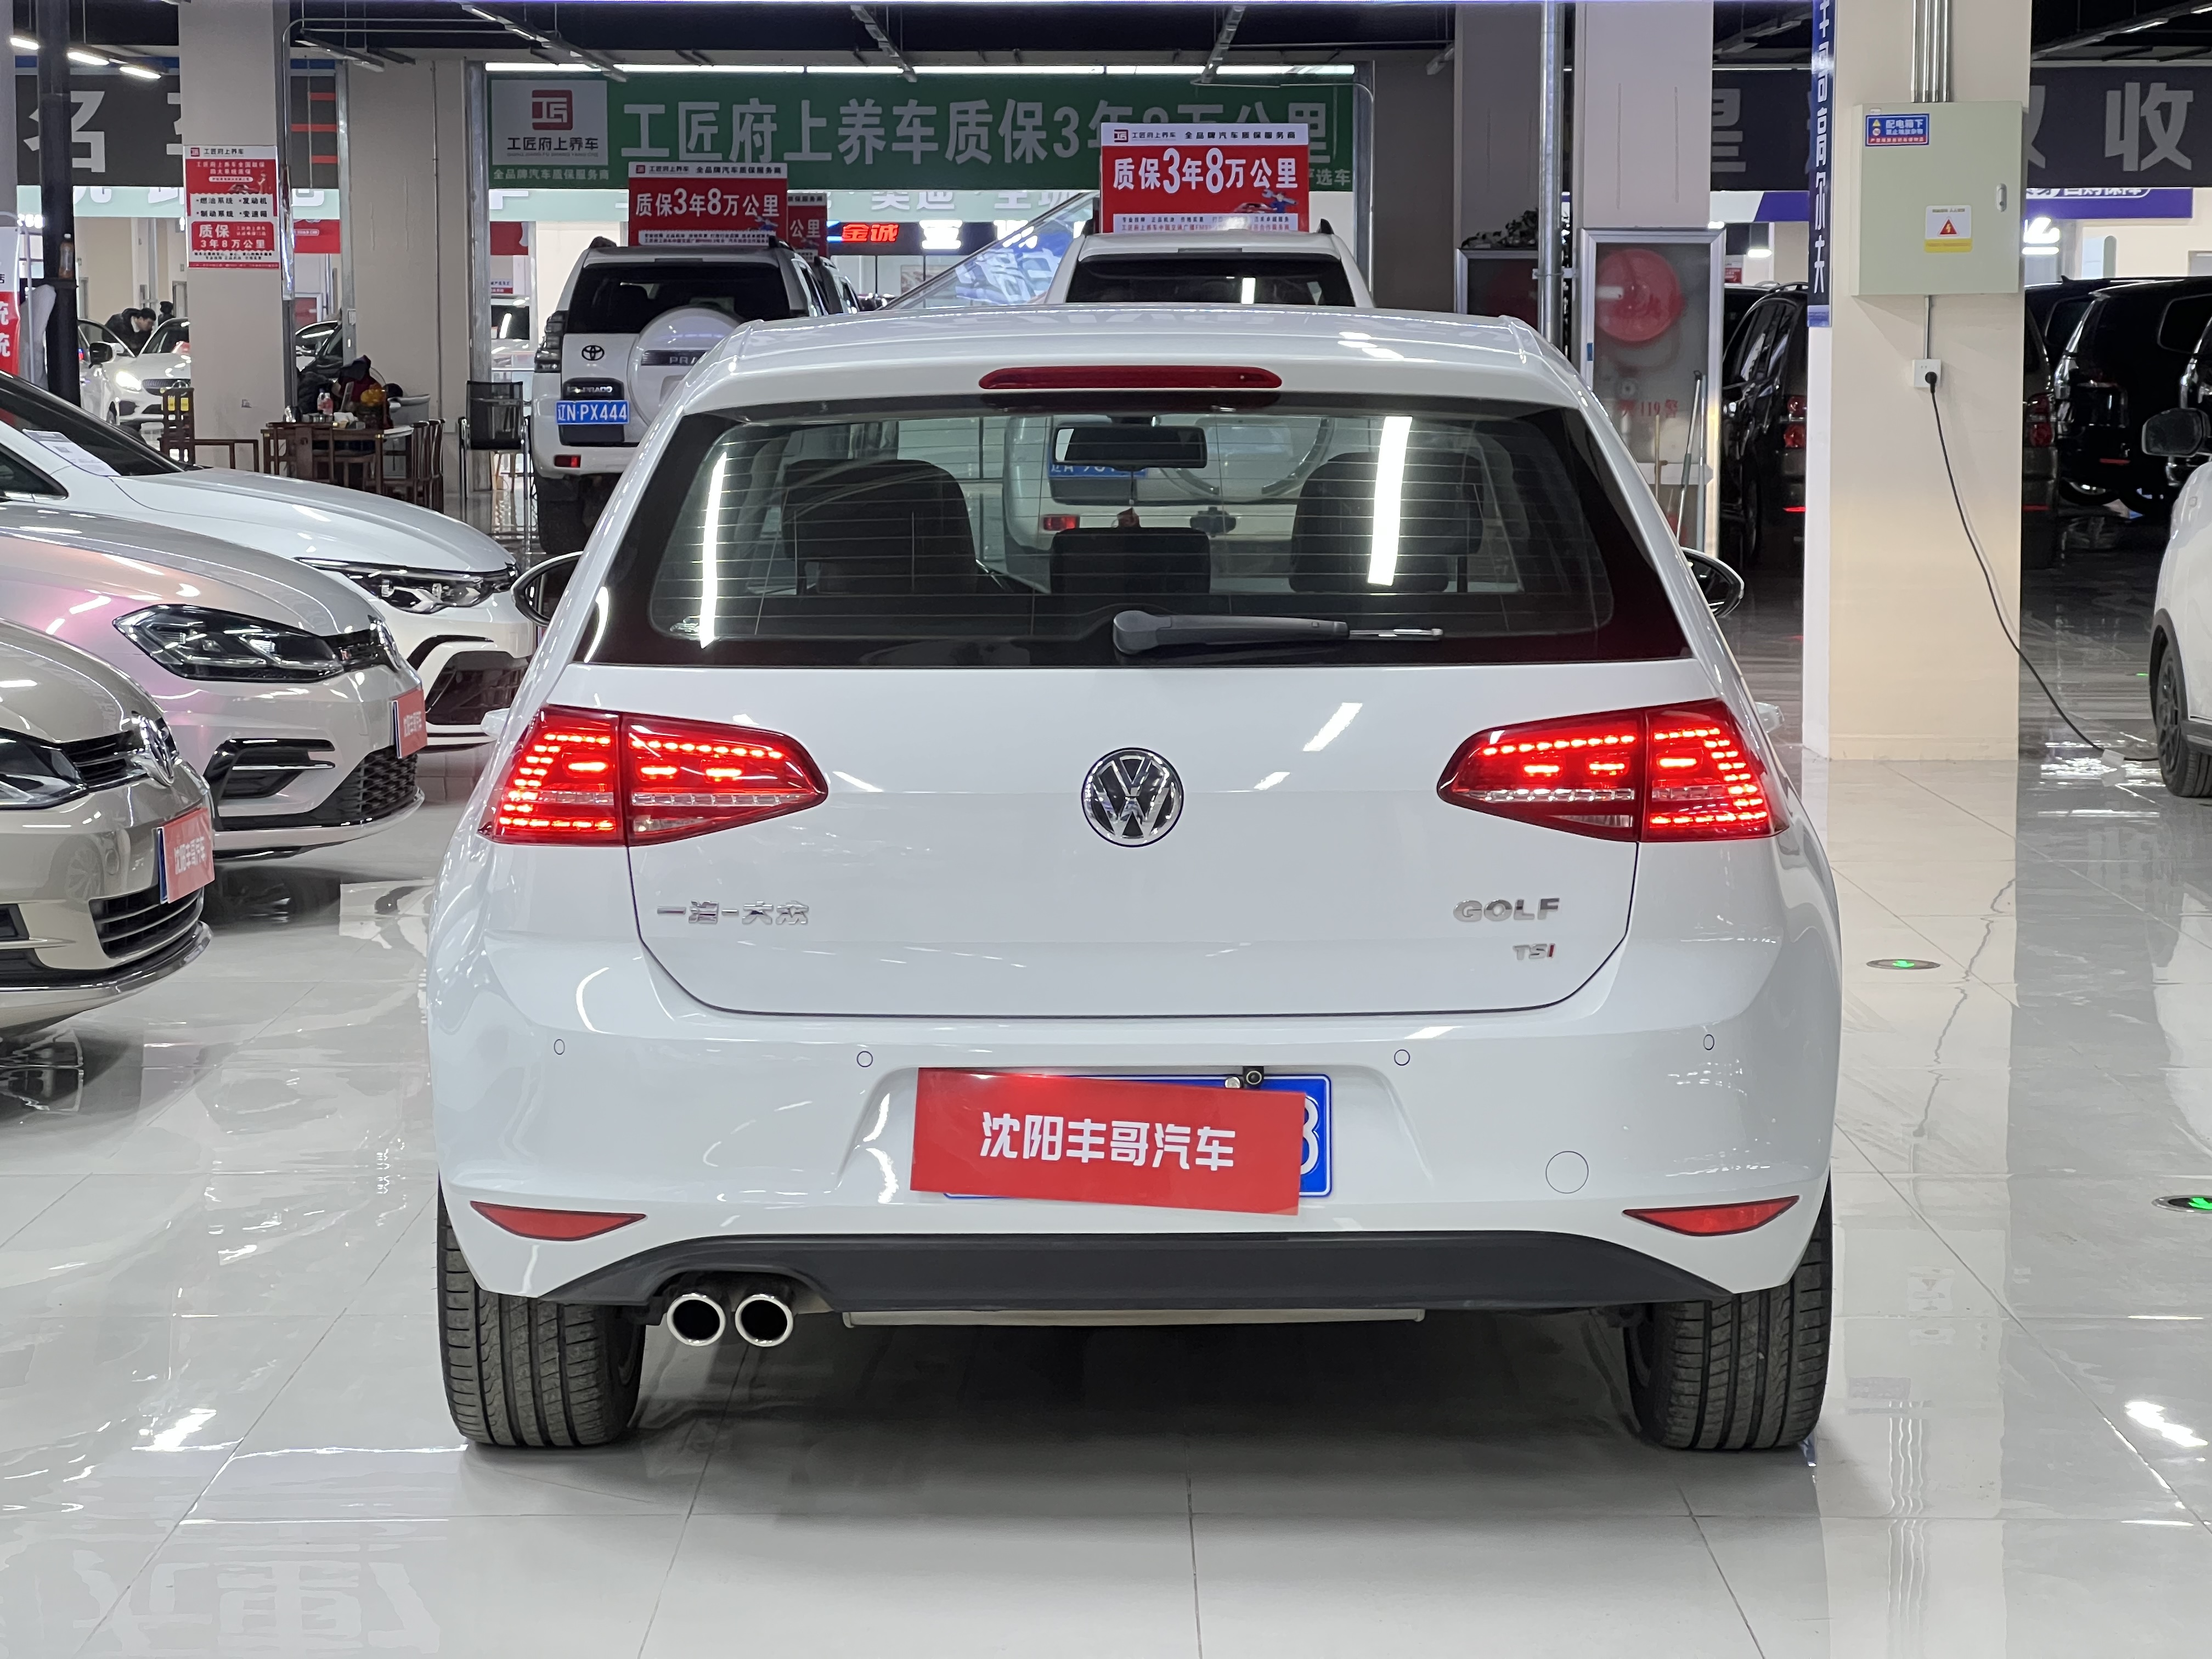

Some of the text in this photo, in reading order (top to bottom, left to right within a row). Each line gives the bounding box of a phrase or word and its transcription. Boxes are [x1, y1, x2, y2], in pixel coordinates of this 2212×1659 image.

[507, 137, 599, 151] 工匠府上养车
[1185, 131, 1296, 139] 全品牌汽车质保服务商
[494, 168, 609, 180] 全品牌汽车质保服务商
[1113, 148, 1298, 194] 质保3年8万公里
[635, 188, 780, 217] 质保3年8万公里
[199, 224, 230, 238] 质保
[789, 218, 821, 238] 公里
[843, 223, 899, 242] 金诚
[200, 239, 265, 249] 3年8万公里
[1453, 898, 1560, 923] GOLF
[1512, 943, 1555, 961] TSI
[980, 1111, 1235, 1171] 沈阳丰哥汽车
